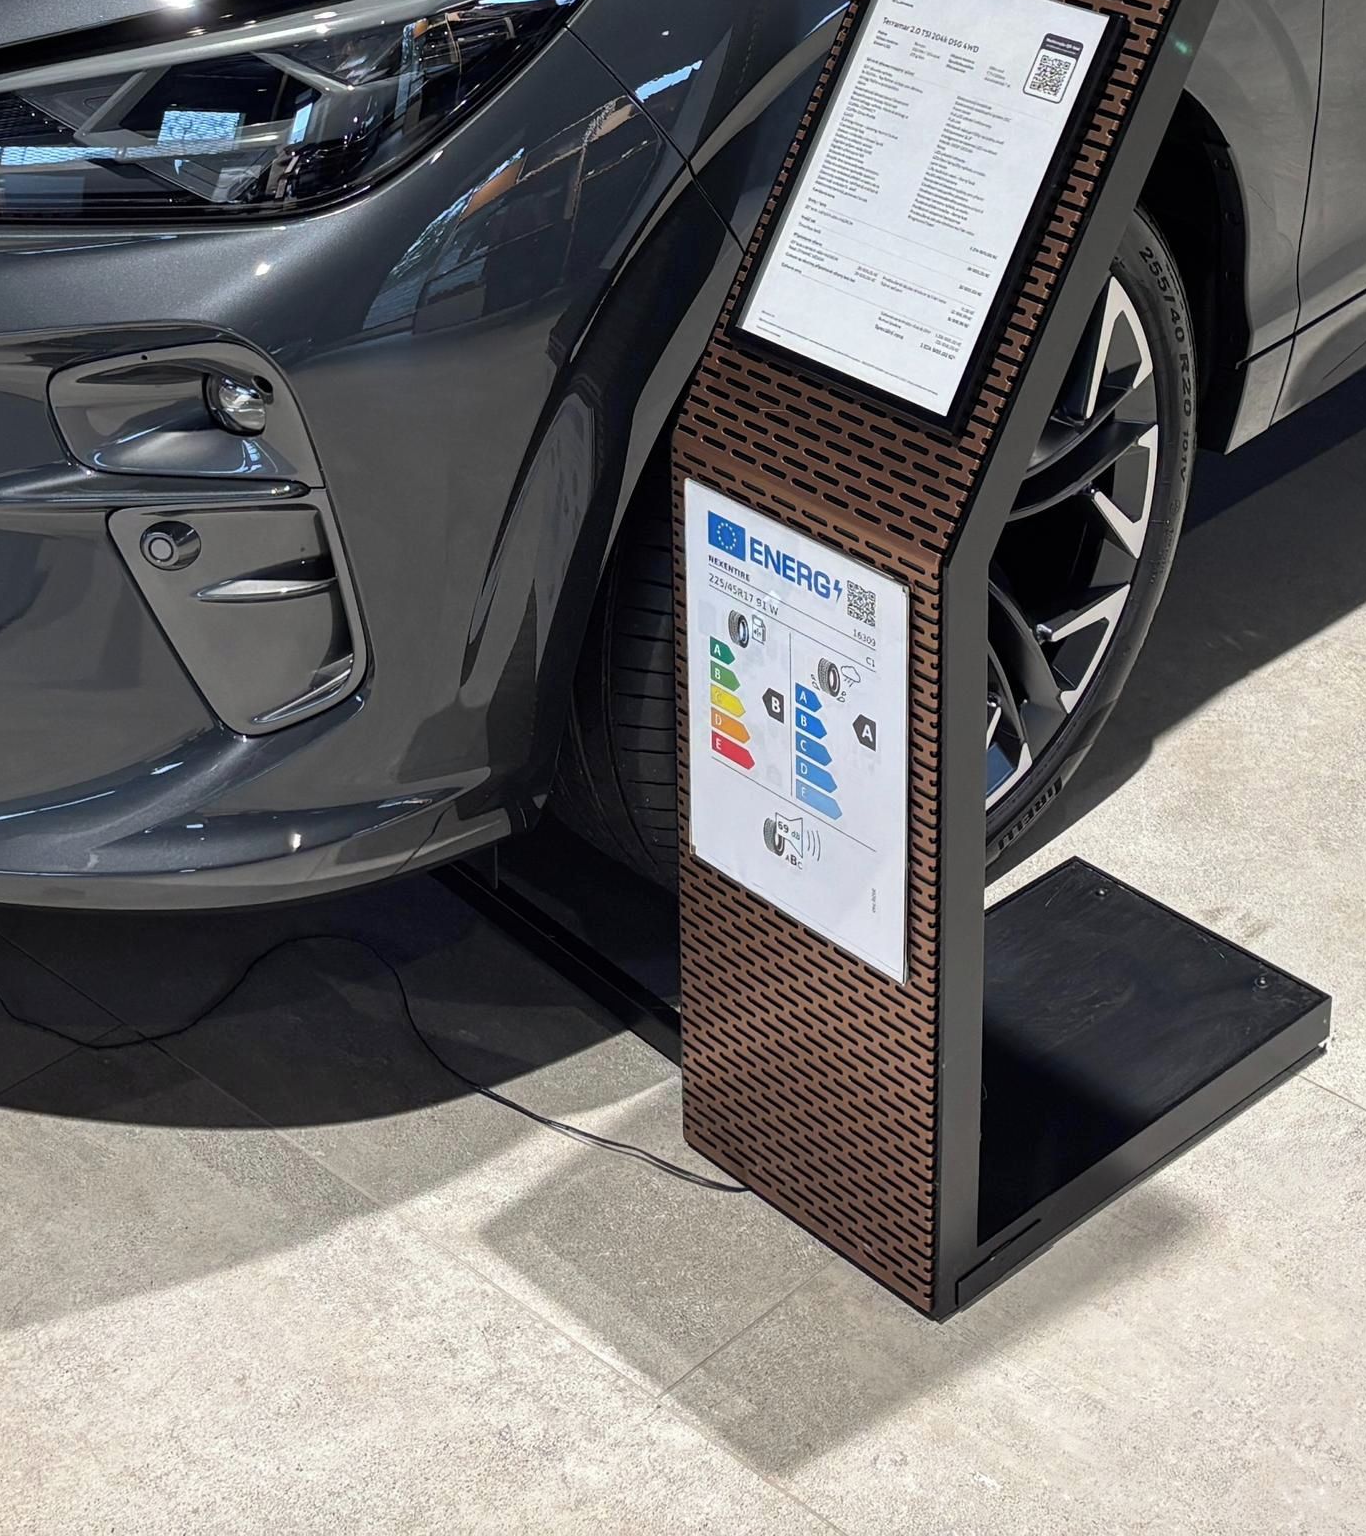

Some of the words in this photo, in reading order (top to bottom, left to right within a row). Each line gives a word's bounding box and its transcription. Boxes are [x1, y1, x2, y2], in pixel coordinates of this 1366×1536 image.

[883, 16, 909, 31] Terramar
[910, 26, 921, 35] 2.0
[948, 38, 963, 48] DSG
[963, 42, 979, 53] 4WD
[1139, 245, 1186, 344] 255/40
[1179, 352, 1192, 418] R20
[708, 555, 751, 581] NEXENTIRE
[749, 536, 831, 600] ENERG
[708, 572, 754, 603] 225/45R17
[756, 597, 767, 610] 91
[769, 603, 779, 616] W
[865, 656, 876, 668] C1
[713, 644, 722, 657] A
[714, 668, 721, 680] B
[771, 697, 781, 713] B
[799, 692, 808, 705] A
[715, 714, 722, 726] D
[800, 715, 807, 727] B
[861, 725, 873, 742] A
[715, 738, 721, 750] E
[800, 740, 807, 752] C
[800, 763, 808, 775] D
[777, 820, 789, 834] 69
